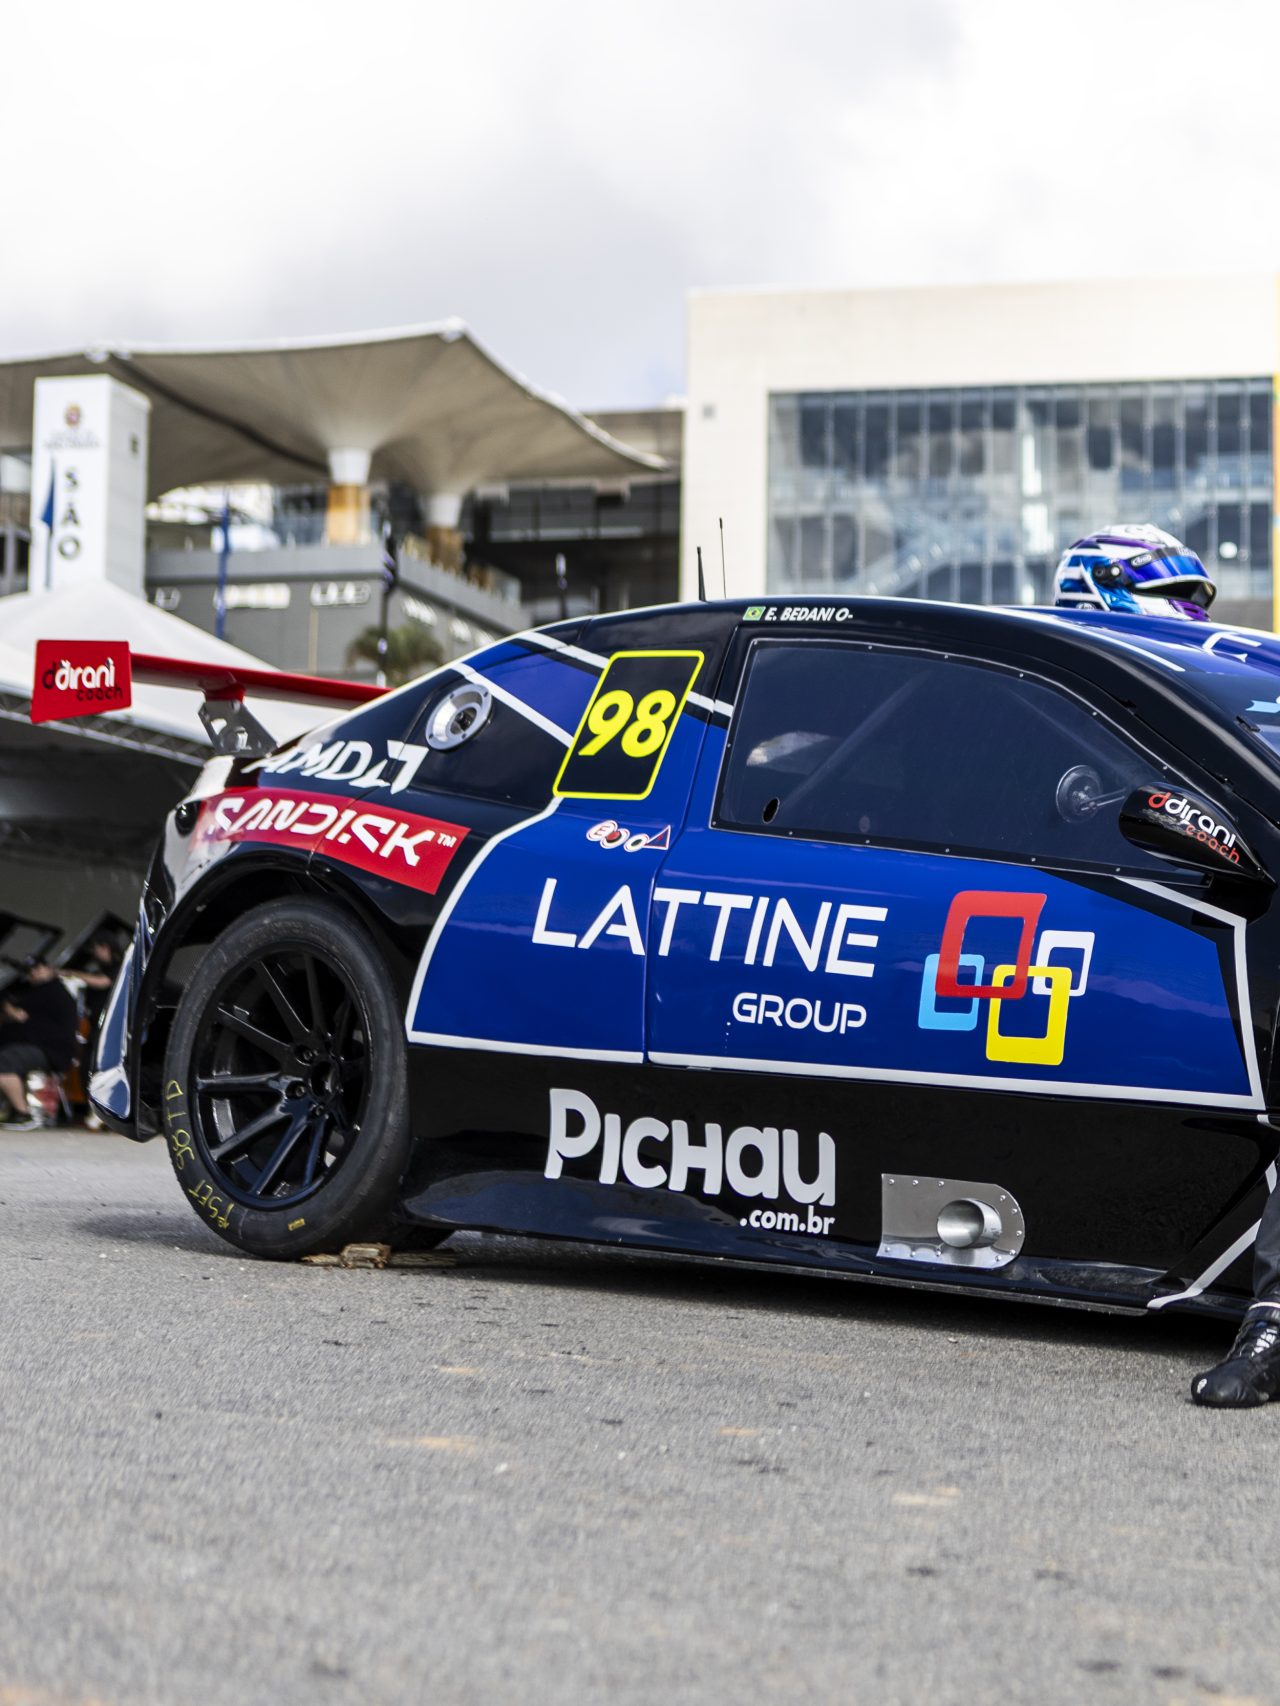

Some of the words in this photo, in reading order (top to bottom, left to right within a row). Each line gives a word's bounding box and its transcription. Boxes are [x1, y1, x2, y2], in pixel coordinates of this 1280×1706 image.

[764, 607, 777, 621] E.
[780, 607, 836, 621] BEDANI
[578, 690, 676, 758] 98
[241, 740, 374, 782] AMD
[1185, 824, 1240, 865] coach
[531, 877, 888, 978] LATTINE
[732, 992, 867, 1034] GROUP
[739, 1205, 836, 1235] .com.br
